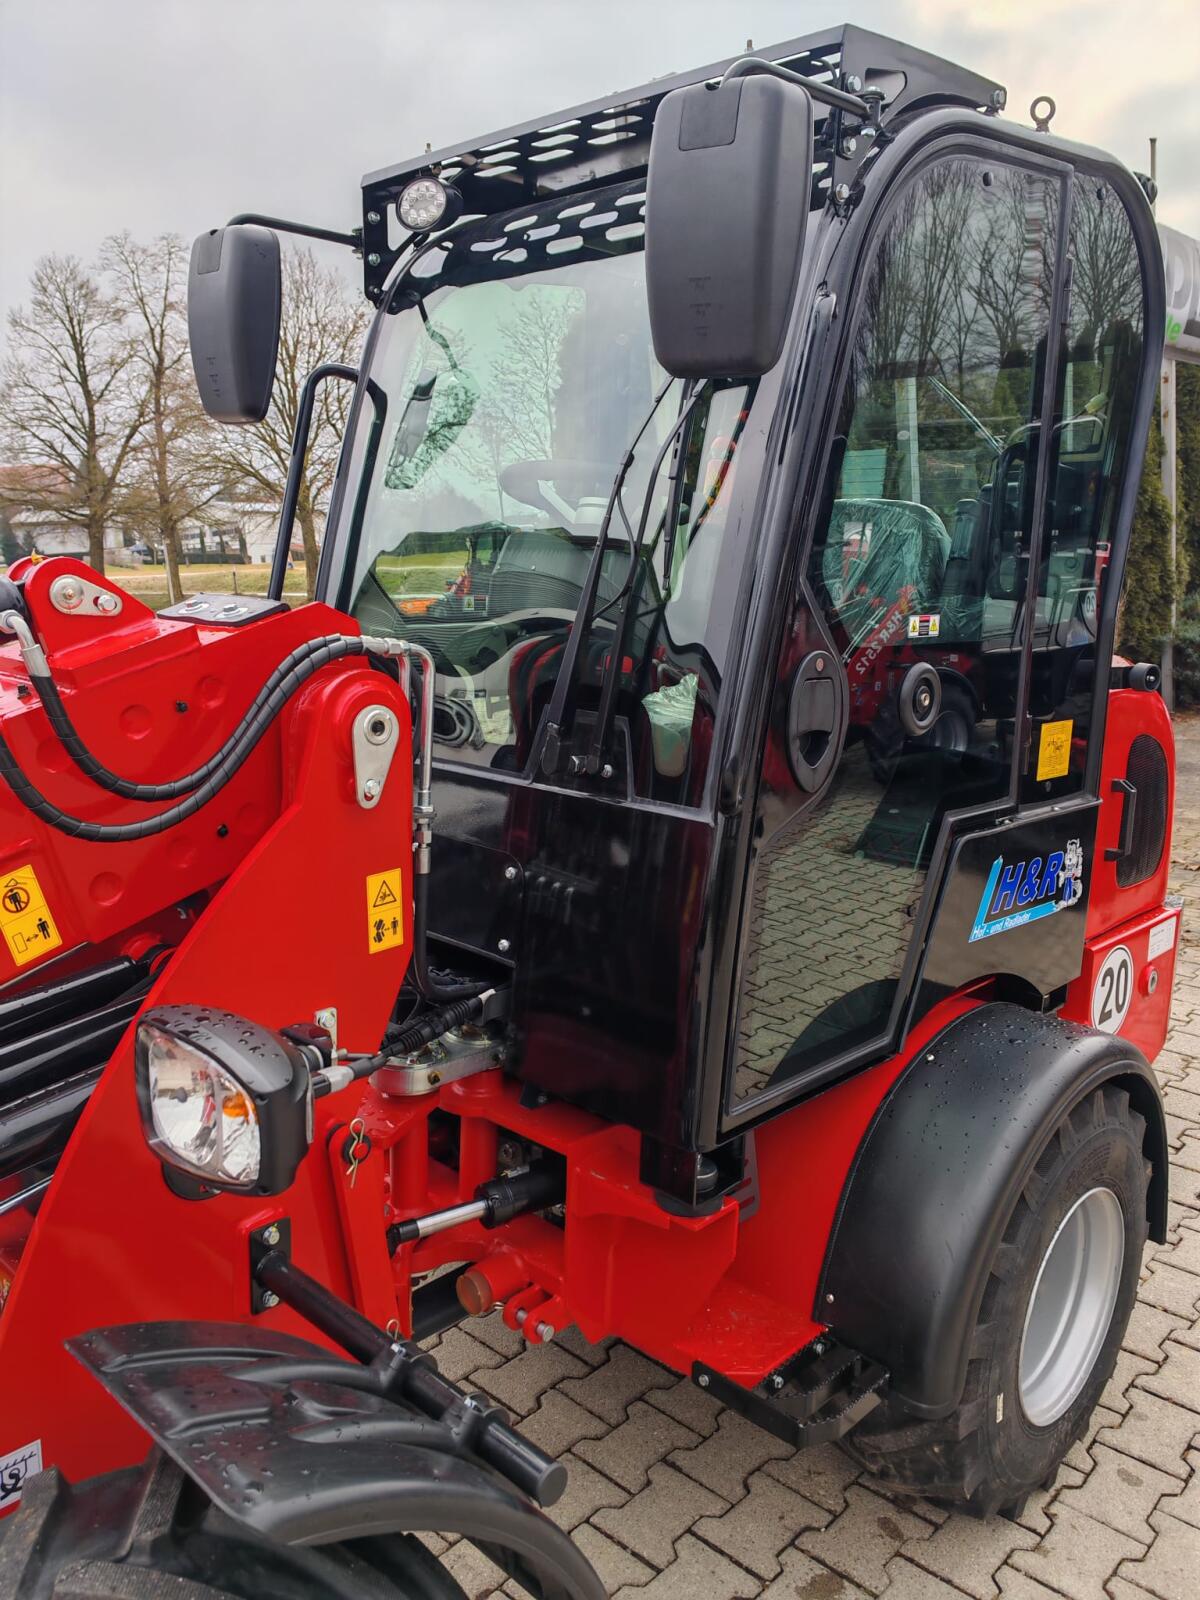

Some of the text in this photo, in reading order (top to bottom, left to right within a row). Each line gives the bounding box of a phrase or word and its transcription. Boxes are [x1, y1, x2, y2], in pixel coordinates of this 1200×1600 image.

[991, 851, 1065, 915] H&R
[1003, 911, 1031, 930] Radlader
[1098, 958, 1128, 1026] 20
